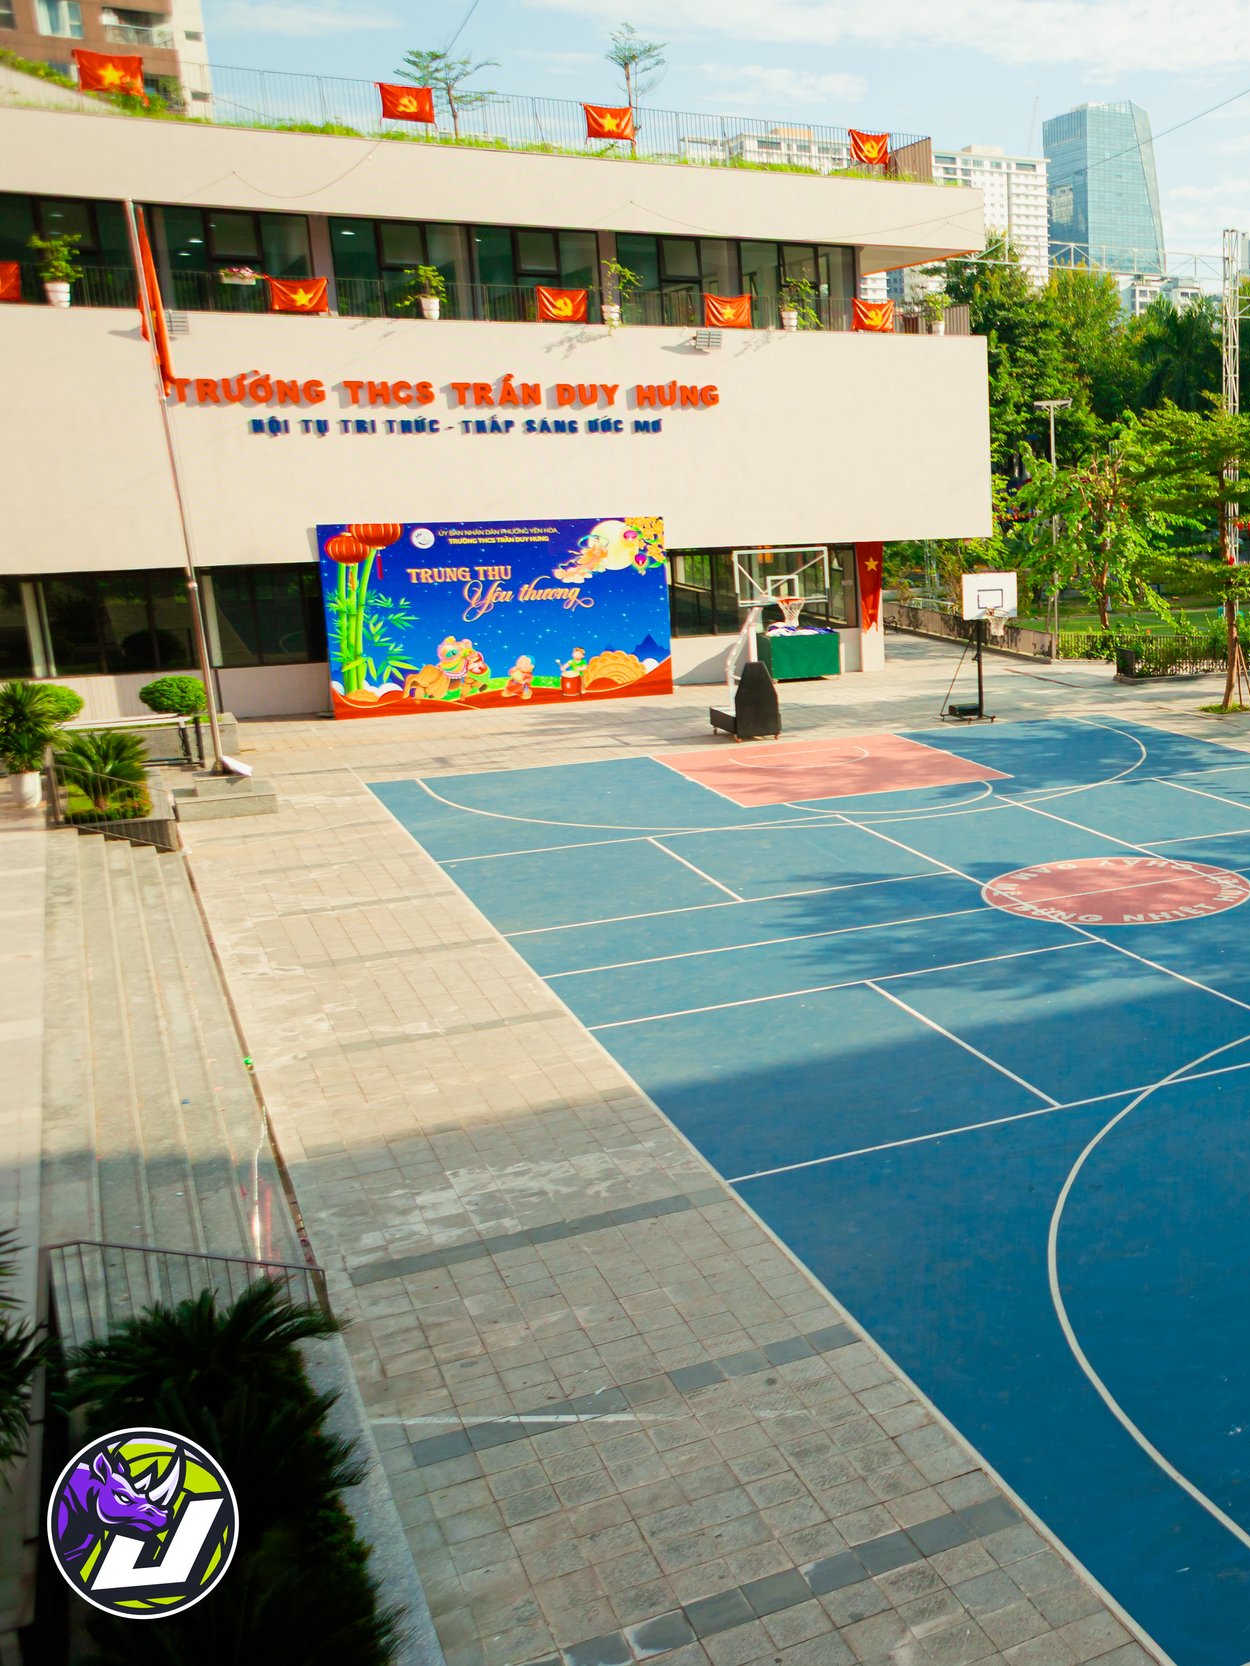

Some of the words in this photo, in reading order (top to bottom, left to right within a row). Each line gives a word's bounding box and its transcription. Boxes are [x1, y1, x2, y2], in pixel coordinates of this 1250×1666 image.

[174, 369, 327, 405] TRƯỜNG
[343, 380, 435, 405] THCS
[451, 373, 542, 406] TRẦN
[556, 382, 620, 407] DUY
[636, 380, 720, 407] HƯNG
[251, 415, 290, 437] HỘI
[301, 419, 330, 437] TỤ
[340, 419, 377, 434] TRI
[386, 415, 441, 434] THỨC
[462, 414, 515, 434] THẮP
[526, 415, 579, 433] SÁNG
[588, 415, 624, 433] ƯỚC
[634, 418, 663, 433] MƠ
[406, 567, 471, 584] TRUNG
[474, 565, 512, 581] THU
[462, 579, 514, 623] Yêu
[517, 575, 595, 612] thương
